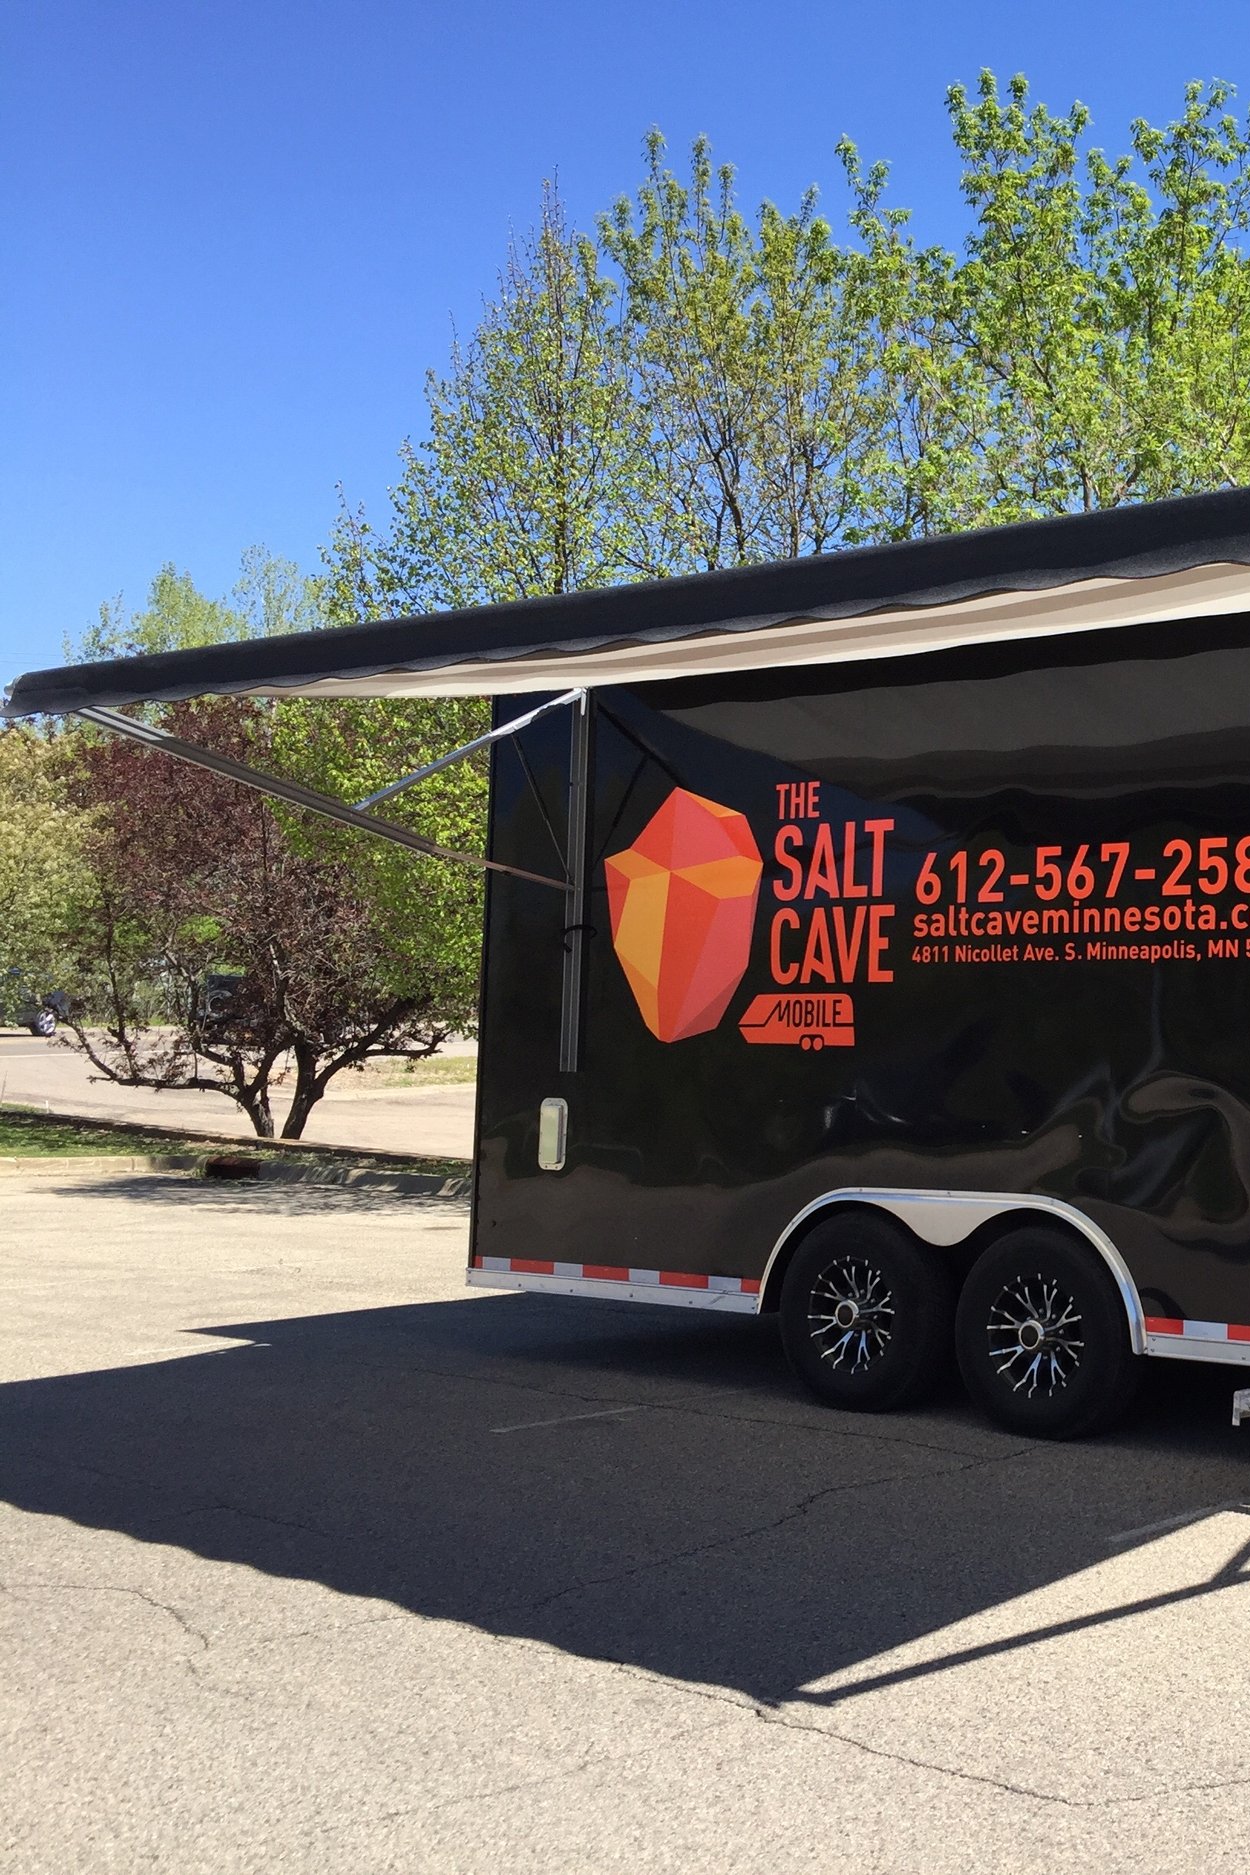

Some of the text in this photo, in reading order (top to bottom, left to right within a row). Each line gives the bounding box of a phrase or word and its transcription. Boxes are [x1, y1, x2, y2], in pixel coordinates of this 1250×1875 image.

[775, 781, 820, 819] THE
[773, 818, 896, 902] SALT
[770, 904, 896, 985] CAVE
[911, 945, 949, 963] 4811
[955, 943, 1019, 962] Nicollet
[1023, 943, 1060, 961] Ave.
[1064, 943, 1083, 961] S.
[1086, 939, 1202, 962] Minneapolis,
[1208, 939, 1240, 958] MN
[766, 999, 846, 1028] MOBILE
